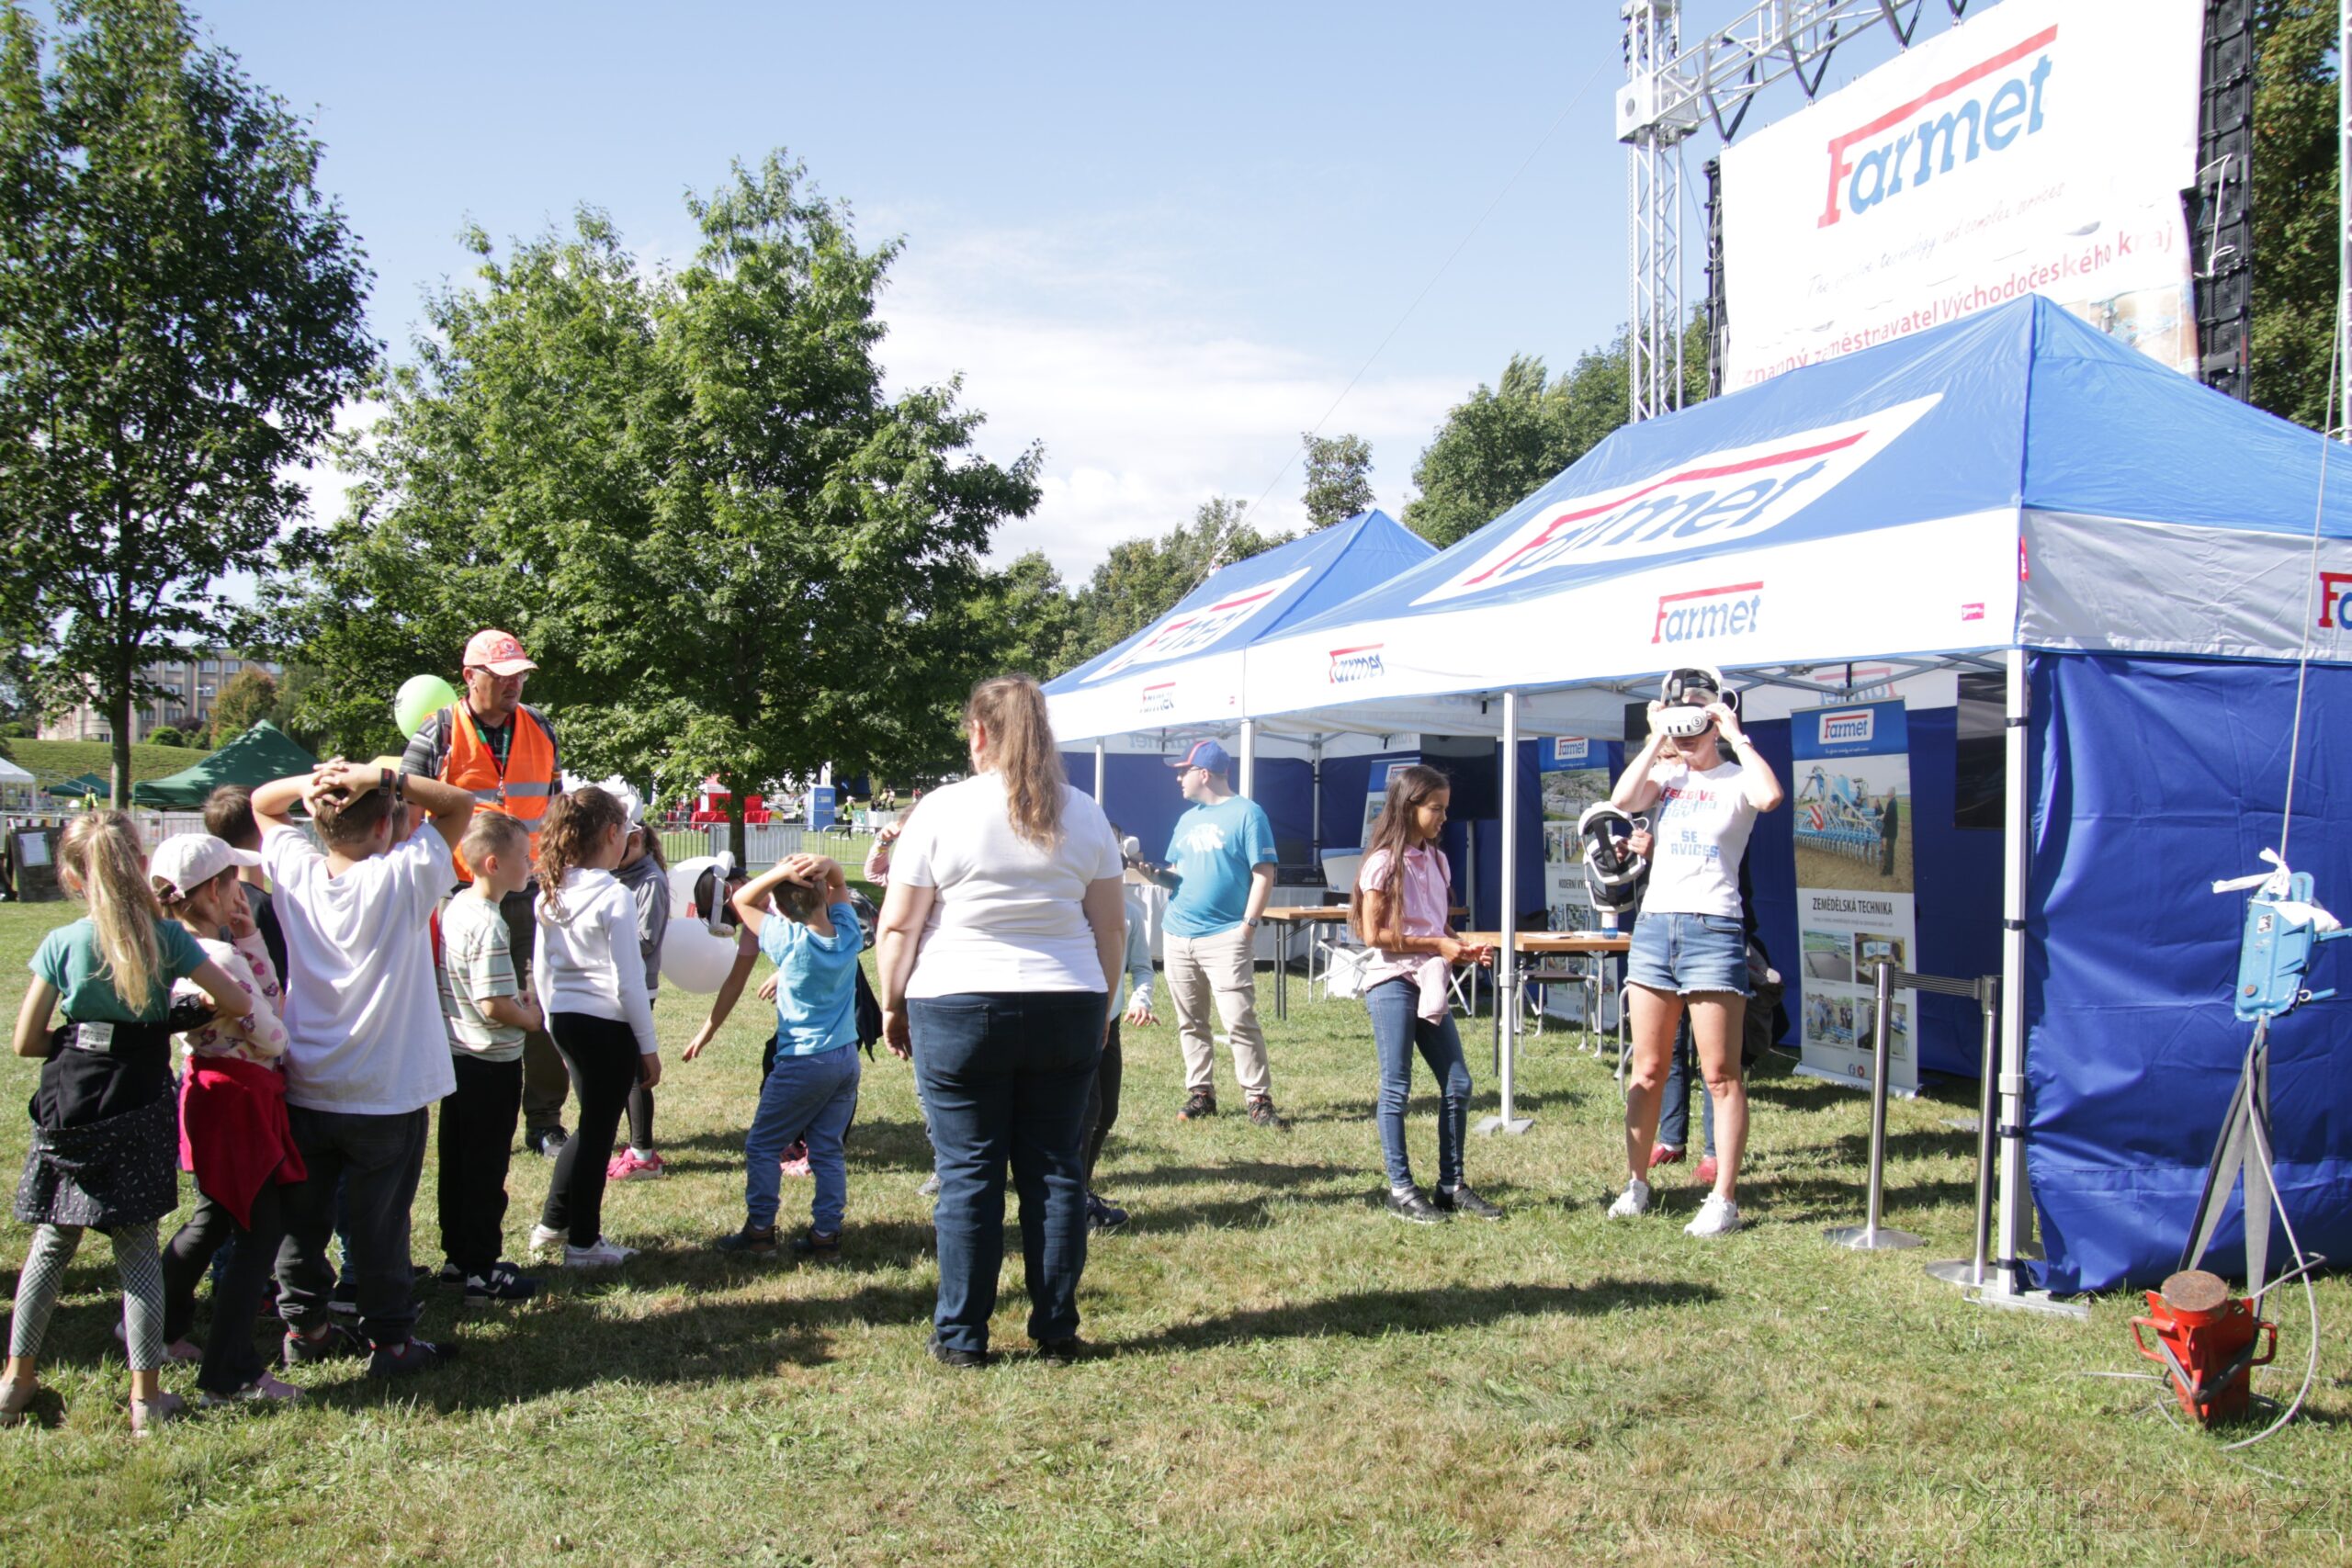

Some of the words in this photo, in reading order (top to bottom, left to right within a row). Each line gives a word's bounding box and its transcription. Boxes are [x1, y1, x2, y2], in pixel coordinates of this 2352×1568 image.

[1817, 24, 2058, 229] Farmet
[1942, 244, 2111, 320] Východočeského
[1462, 430, 1870, 586] Farmet
[1651, 581, 1764, 644] Farmet
[1329, 643, 1385, 683] Farmet
[1558, 736, 1585, 756] Farmet
[1824, 714, 1869, 739] Farmet
[1813, 896, 1857, 913] ZEMĚDĚLSKÁ
[1858, 900, 1893, 916] TECHNIKA
